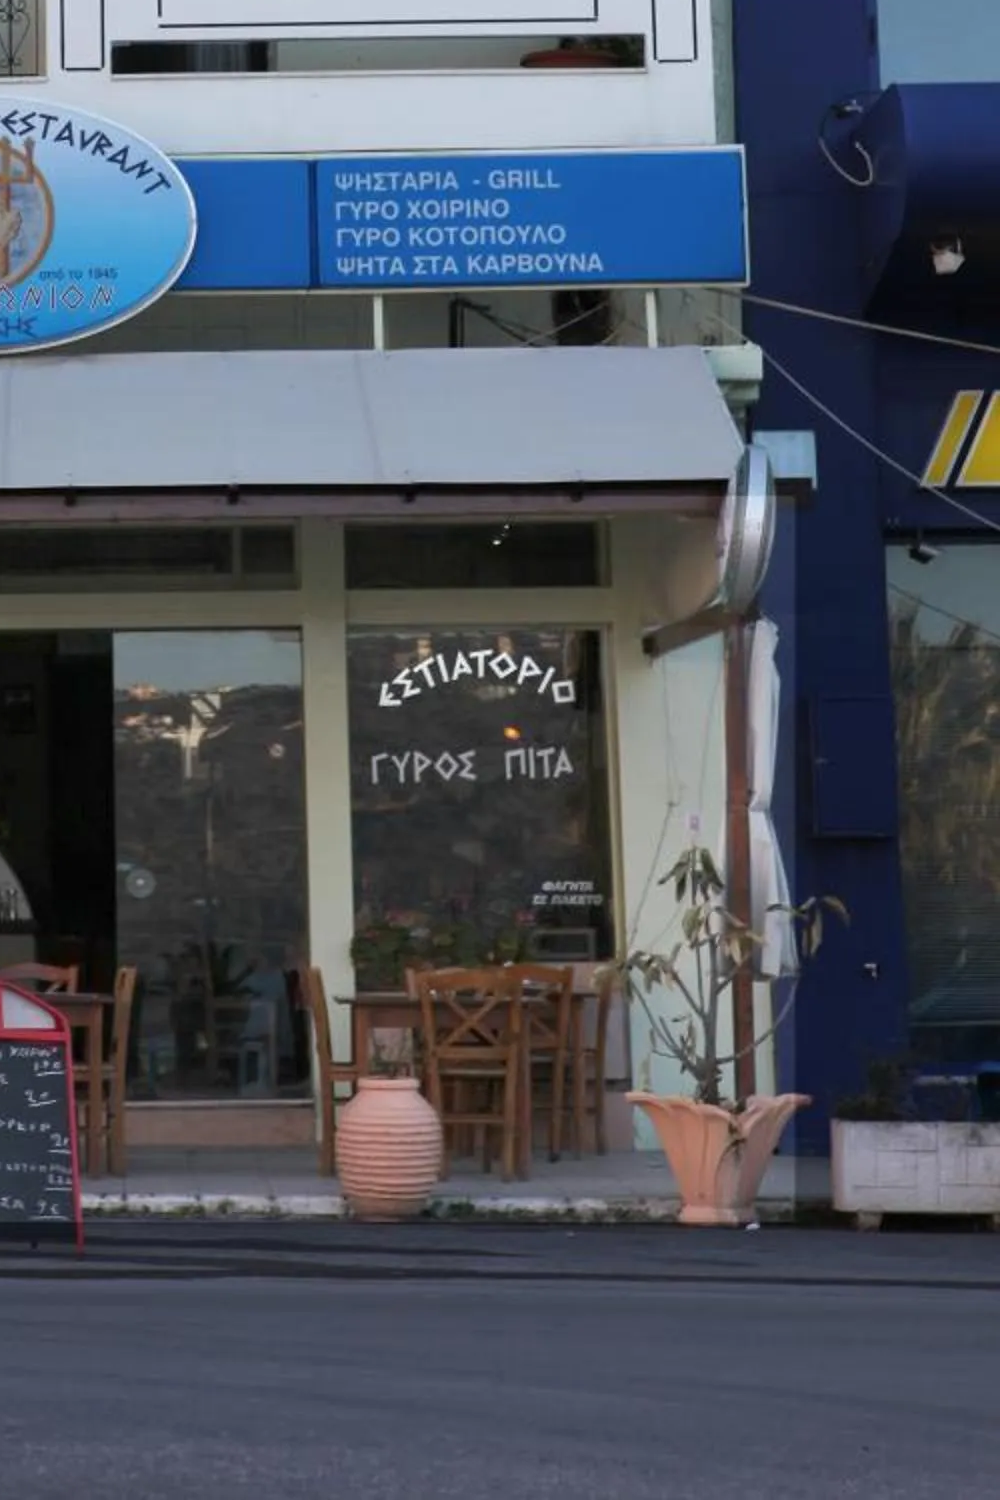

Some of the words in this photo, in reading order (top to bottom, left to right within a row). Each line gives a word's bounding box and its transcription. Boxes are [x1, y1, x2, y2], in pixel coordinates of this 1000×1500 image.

[335, 171, 459, 191] ΨΗΣΤΑΡΙΑ
[488, 170, 561, 190] GRILL
[336, 201, 399, 220] ΓΥΡΟ
[408, 199, 510, 220] ΧΟΙΡΙΝΟ
[337, 228, 400, 248] ΓΥΡΟ
[409, 225, 566, 247] ΚΟΤΟΠΟΥΛΟ
[337, 256, 406, 276] ΨΗΤΑ
[413, 255, 459, 275] ΣΤΑ
[467, 252, 604, 274] ΚΑΡΒΟΥΝΑ
[379, 649, 576, 707] ΕΣΤΙΑΤΟΡΙΟ
[371, 750, 477, 784] ΓΥΡΟΣ
[504, 747, 574, 780] ΠΙΤΑ
